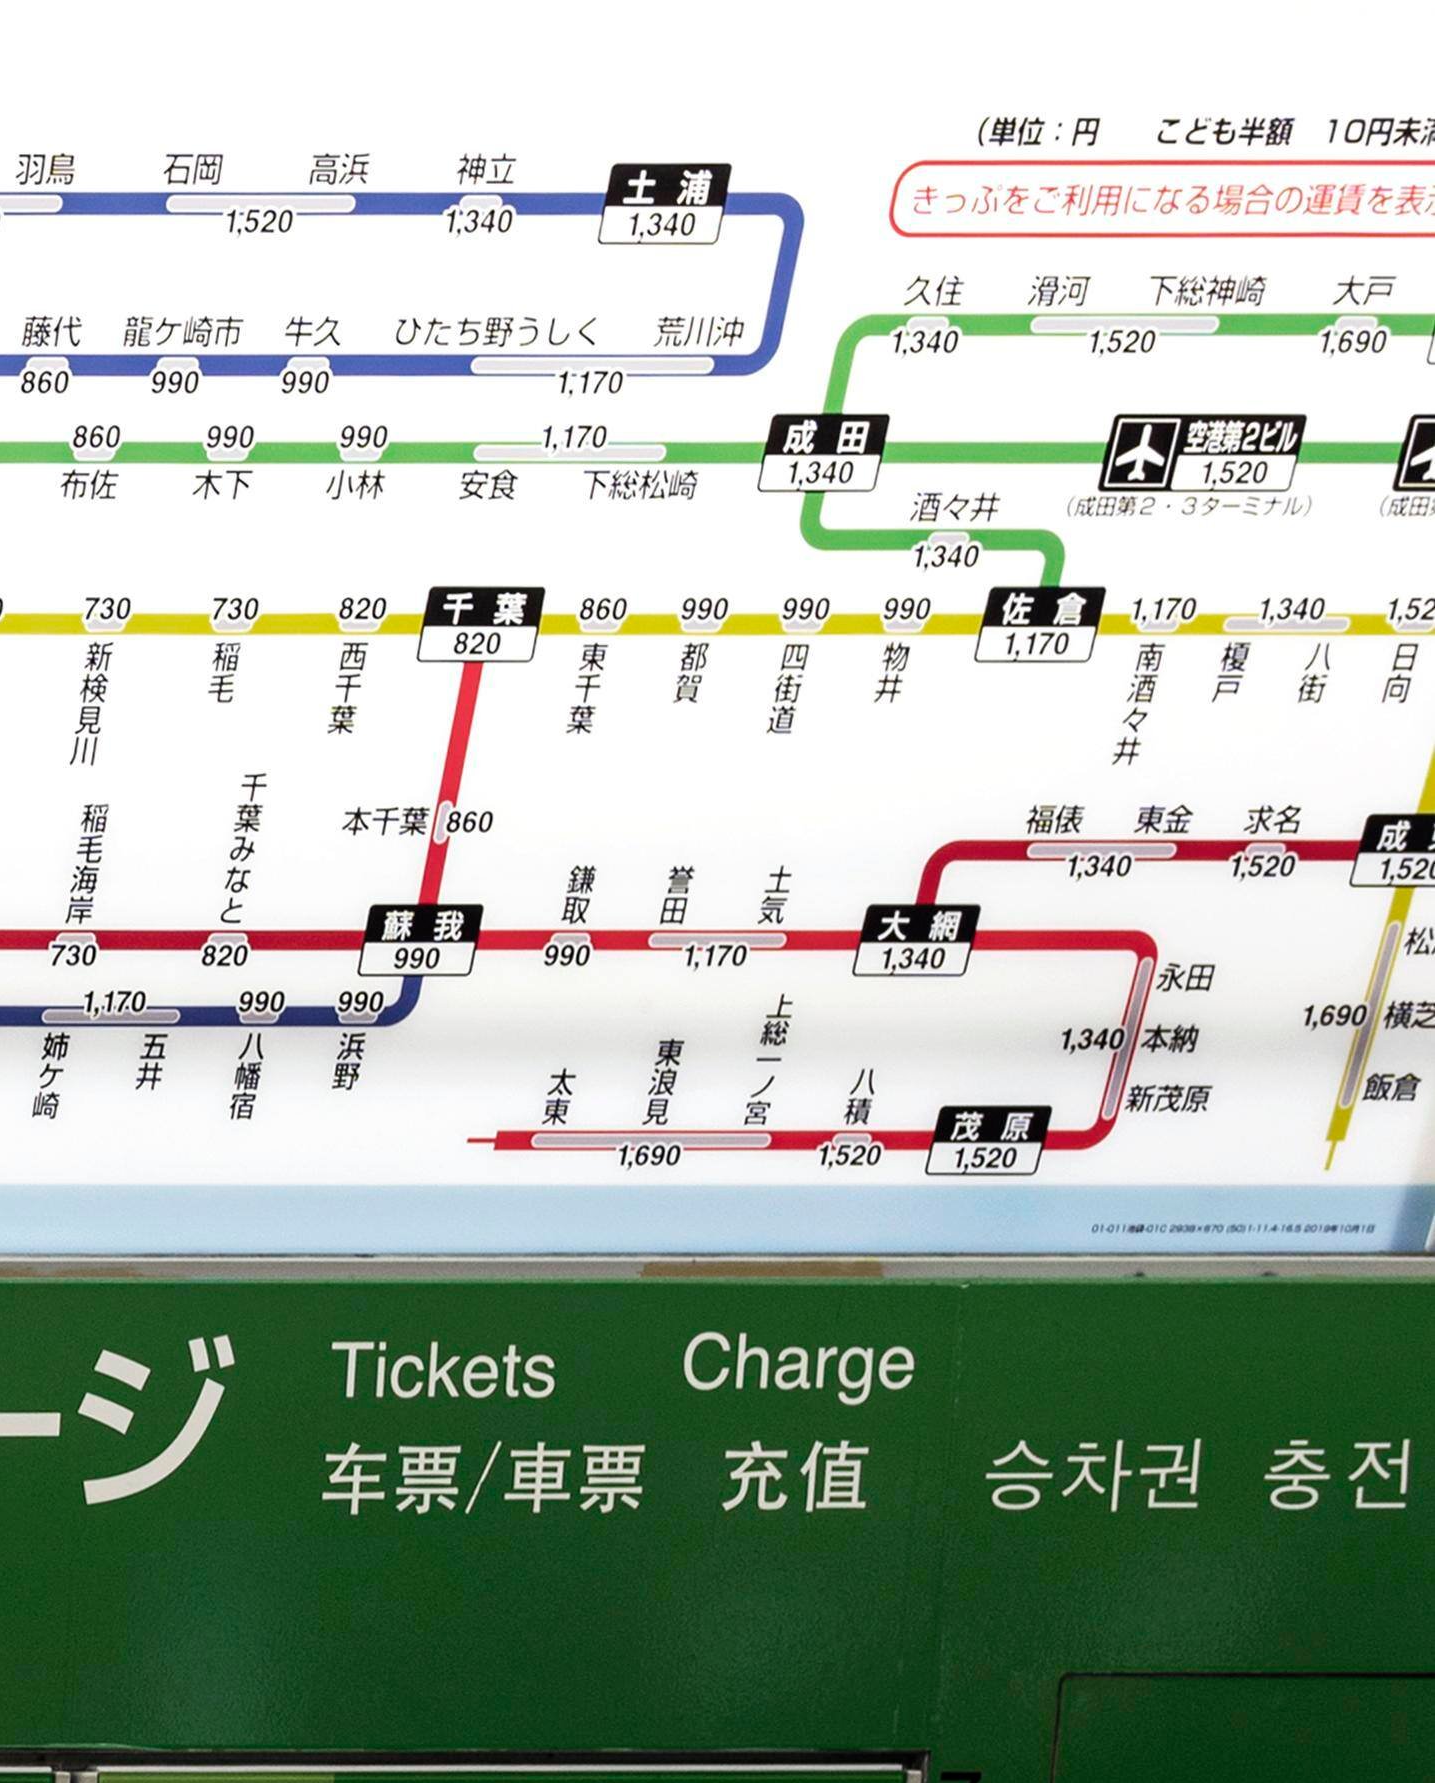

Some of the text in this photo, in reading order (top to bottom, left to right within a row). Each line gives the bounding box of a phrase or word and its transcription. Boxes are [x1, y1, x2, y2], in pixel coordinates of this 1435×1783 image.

[1157, 117, 1295, 146] こども半額
[15, 153, 75, 185] 羽鳥
[1151, 276, 1265, 306] 下総神崎
[659, 316, 745, 347] 荒川沖
[589, 470, 697, 500] 下総松崎
[910, 493, 1000, 522] 酒々井
[342, 807, 430, 836] 本千葉
[1026, 805, 1083, 834] 福俵
[1243, 805, 1301, 835] 求名
[220, 773, 267, 924] 千葉みなと
[1125, 1084, 1213, 1113] 新茂原
[331, 1331, 915, 1406] Tickets Charge
[722, 1439, 870, 1513] 充值
[985, 1438, 1202, 1513] 승차권
[1264, 1438, 1410, 1510] 충전
